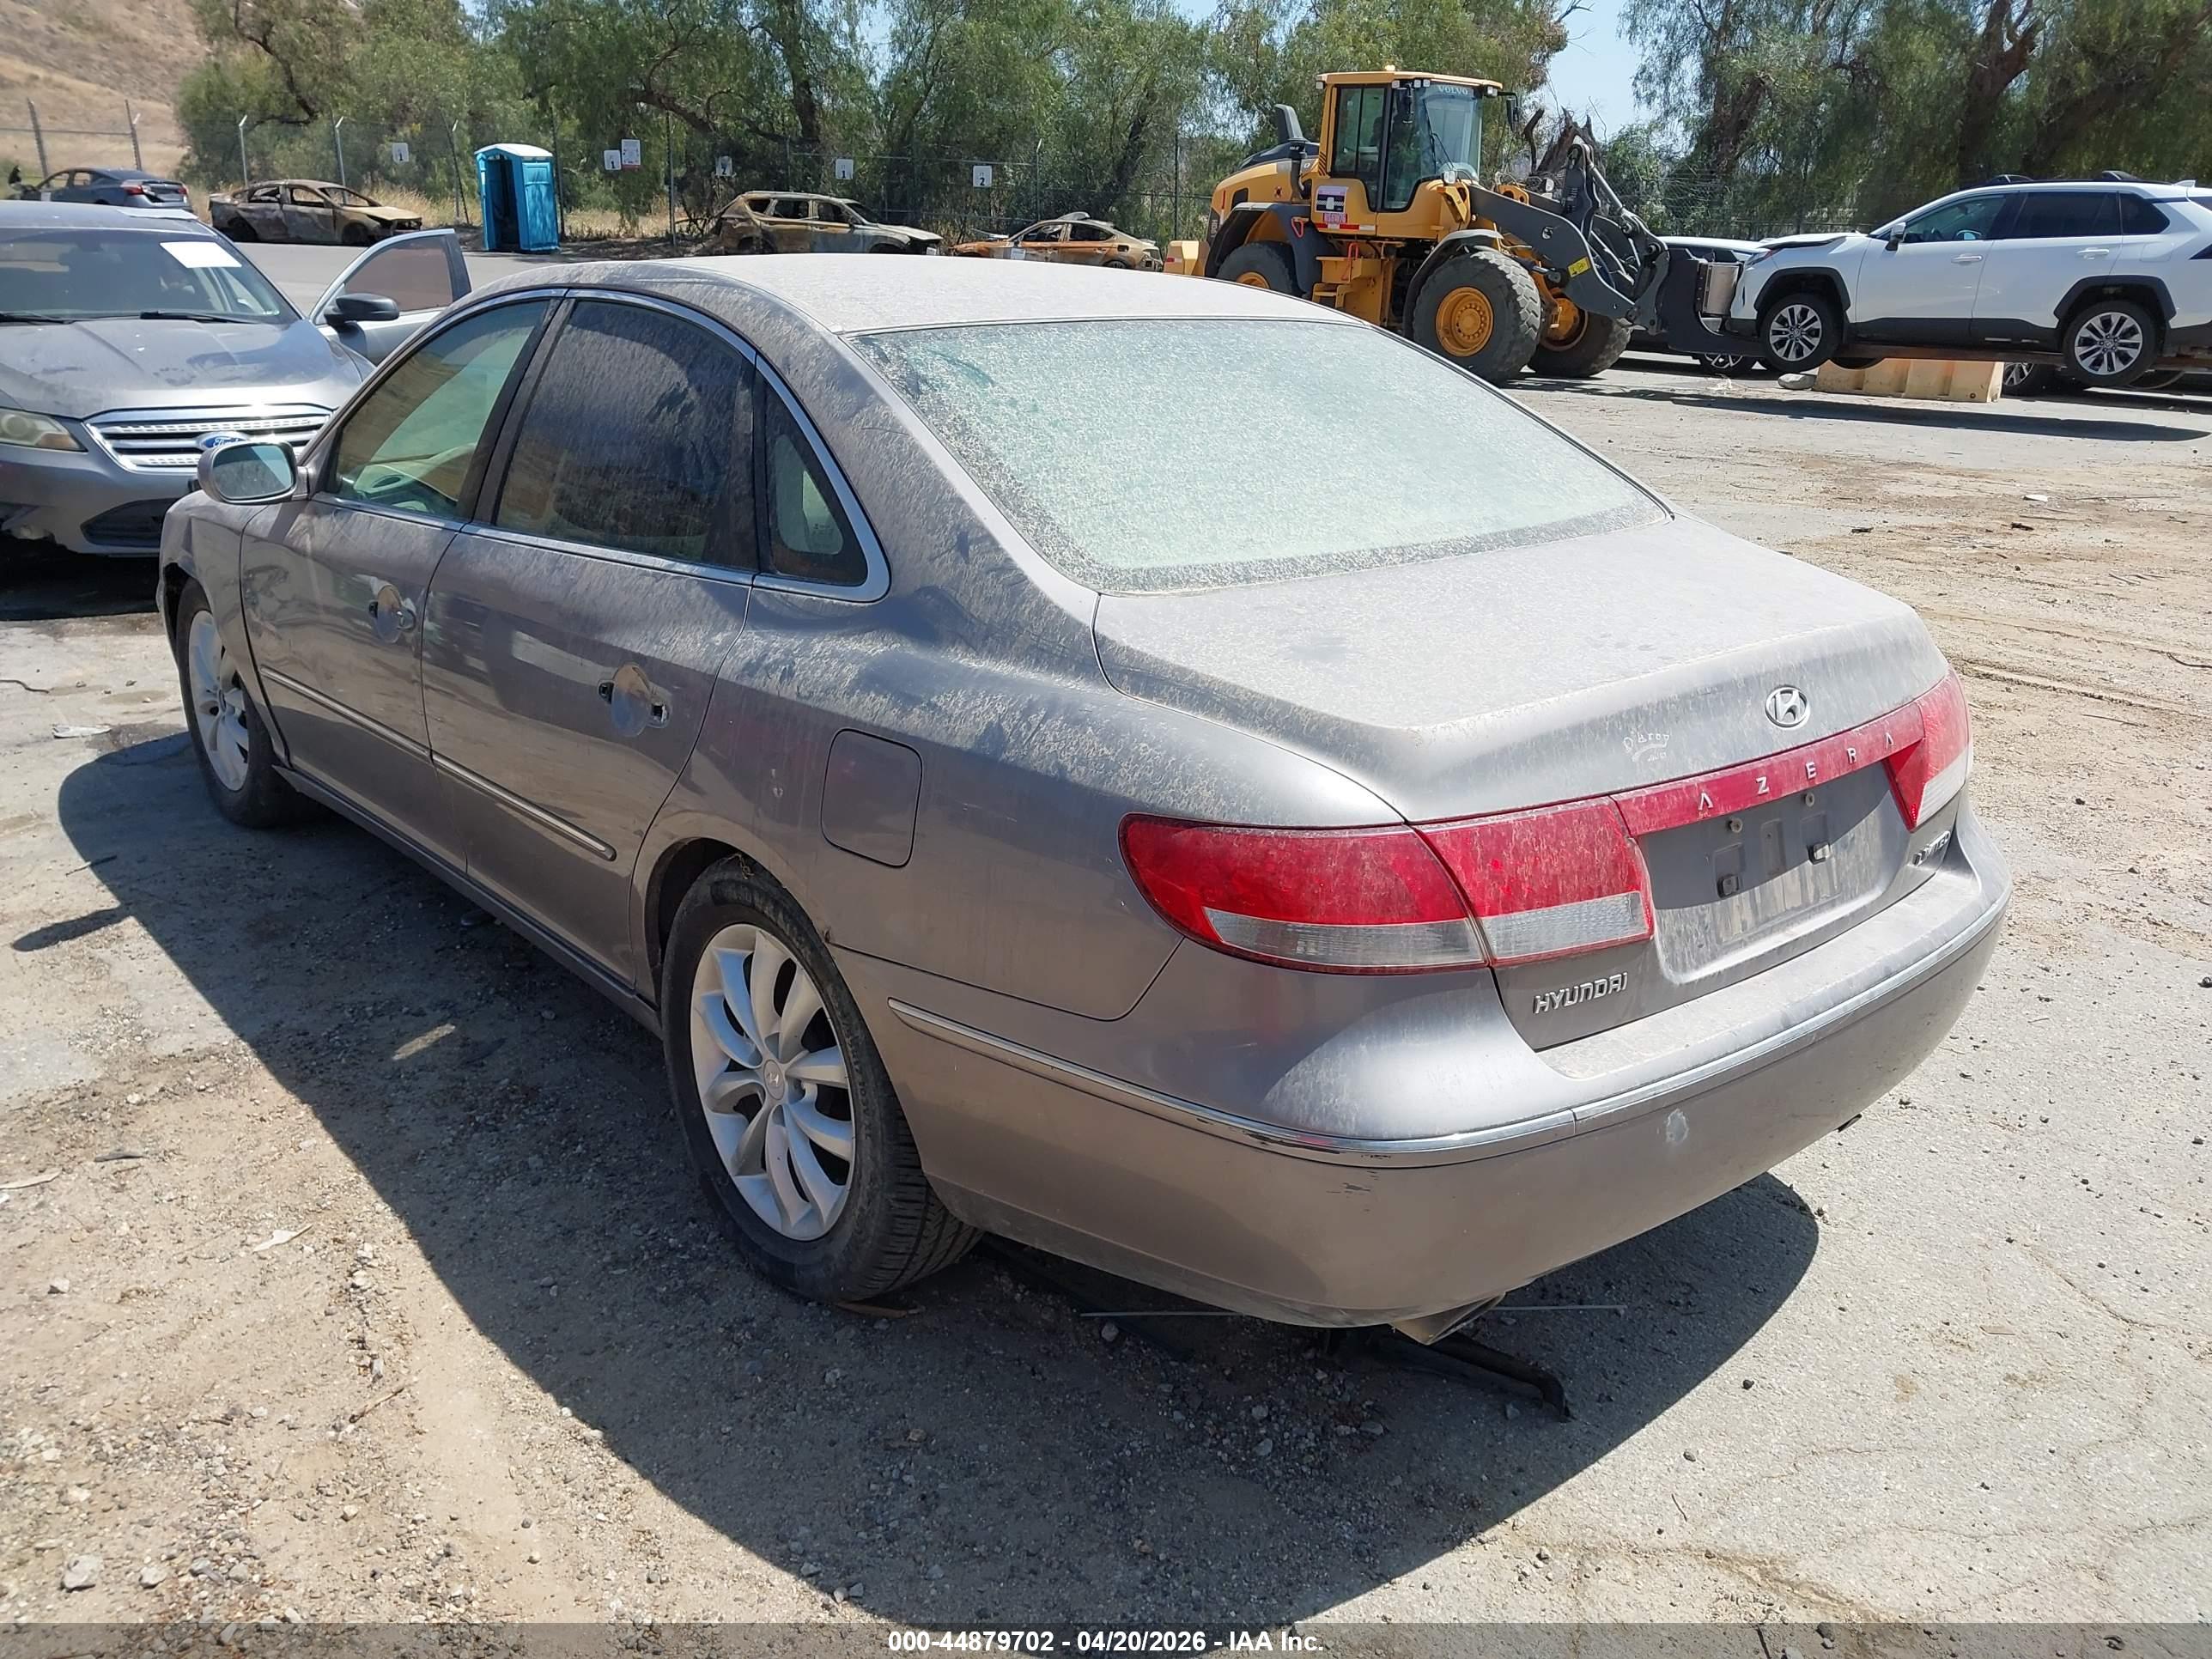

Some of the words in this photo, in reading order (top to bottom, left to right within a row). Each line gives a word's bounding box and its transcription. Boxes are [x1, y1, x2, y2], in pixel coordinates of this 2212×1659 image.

[1437, 85, 1468, 95] VOLVO
[979, 177, 986, 186] 2
[1698, 732, 1894, 811] AZERA
[1532, 972, 1628, 1014] HYUNDAI
